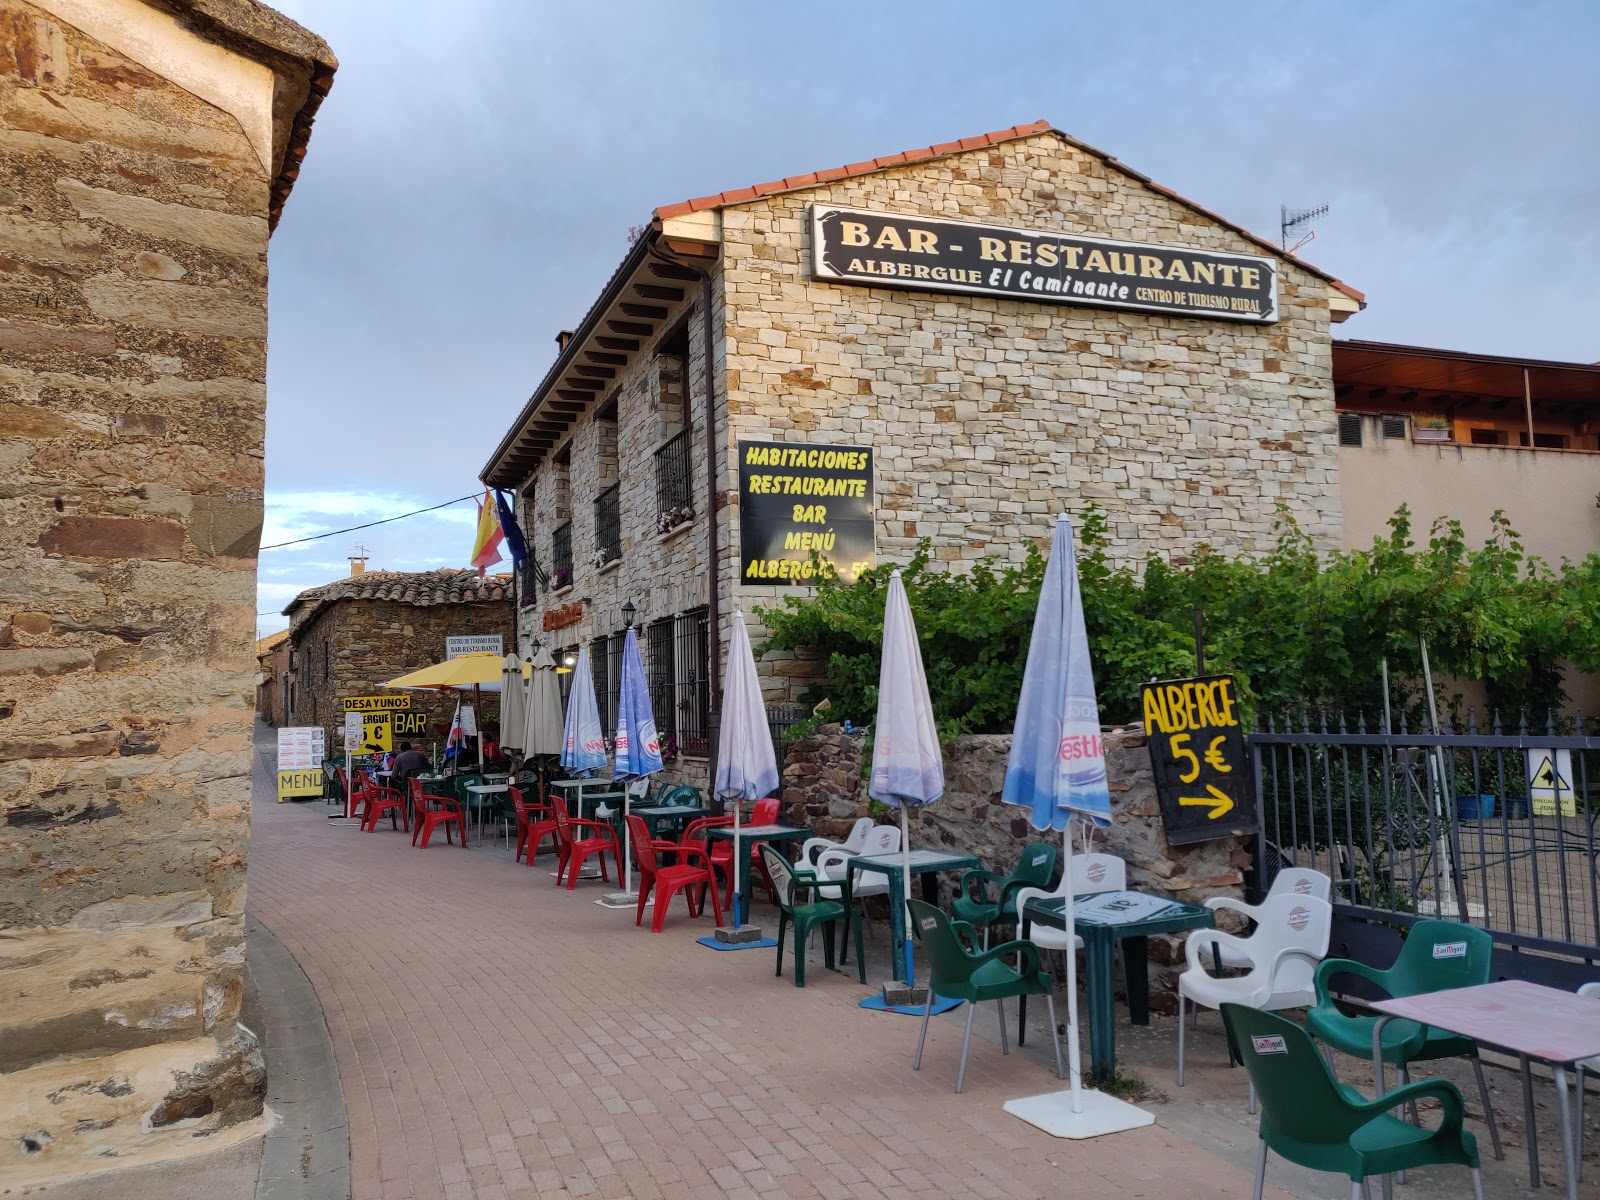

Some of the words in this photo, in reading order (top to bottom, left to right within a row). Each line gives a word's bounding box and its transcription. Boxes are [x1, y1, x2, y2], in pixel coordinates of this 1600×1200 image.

[840, 221, 939, 255] BAR
[978, 237, 1260, 290] RESTAURANTE
[847, 258, 982, 284] ALBERGUE
[988, 267, 1012, 287] El
[1019, 270, 1129, 300] Caminante
[1135, 286, 1172, 304] CENTRO
[1174, 291, 1187, 306] DE
[1188, 292, 1229, 310] TURISMO
[1231, 297, 1261, 313] RURAL
[745, 446, 868, 471] HABITACIONES
[749, 474, 867, 498] RESTAURANTE
[792, 504, 827, 525] BAR
[784, 528, 836, 551] MENÚ
[345, 698, 409, 709] DESAYUNOS
[1143, 679, 1238, 736] ALBERGE
[363, 714, 389, 724] ERGUE
[394, 713, 427, 734] BAR
[373, 726, 383, 740] €
[1169, 733, 1200, 784] 5
[1204, 735, 1232, 773] €
[281, 773, 323, 789] MENU
